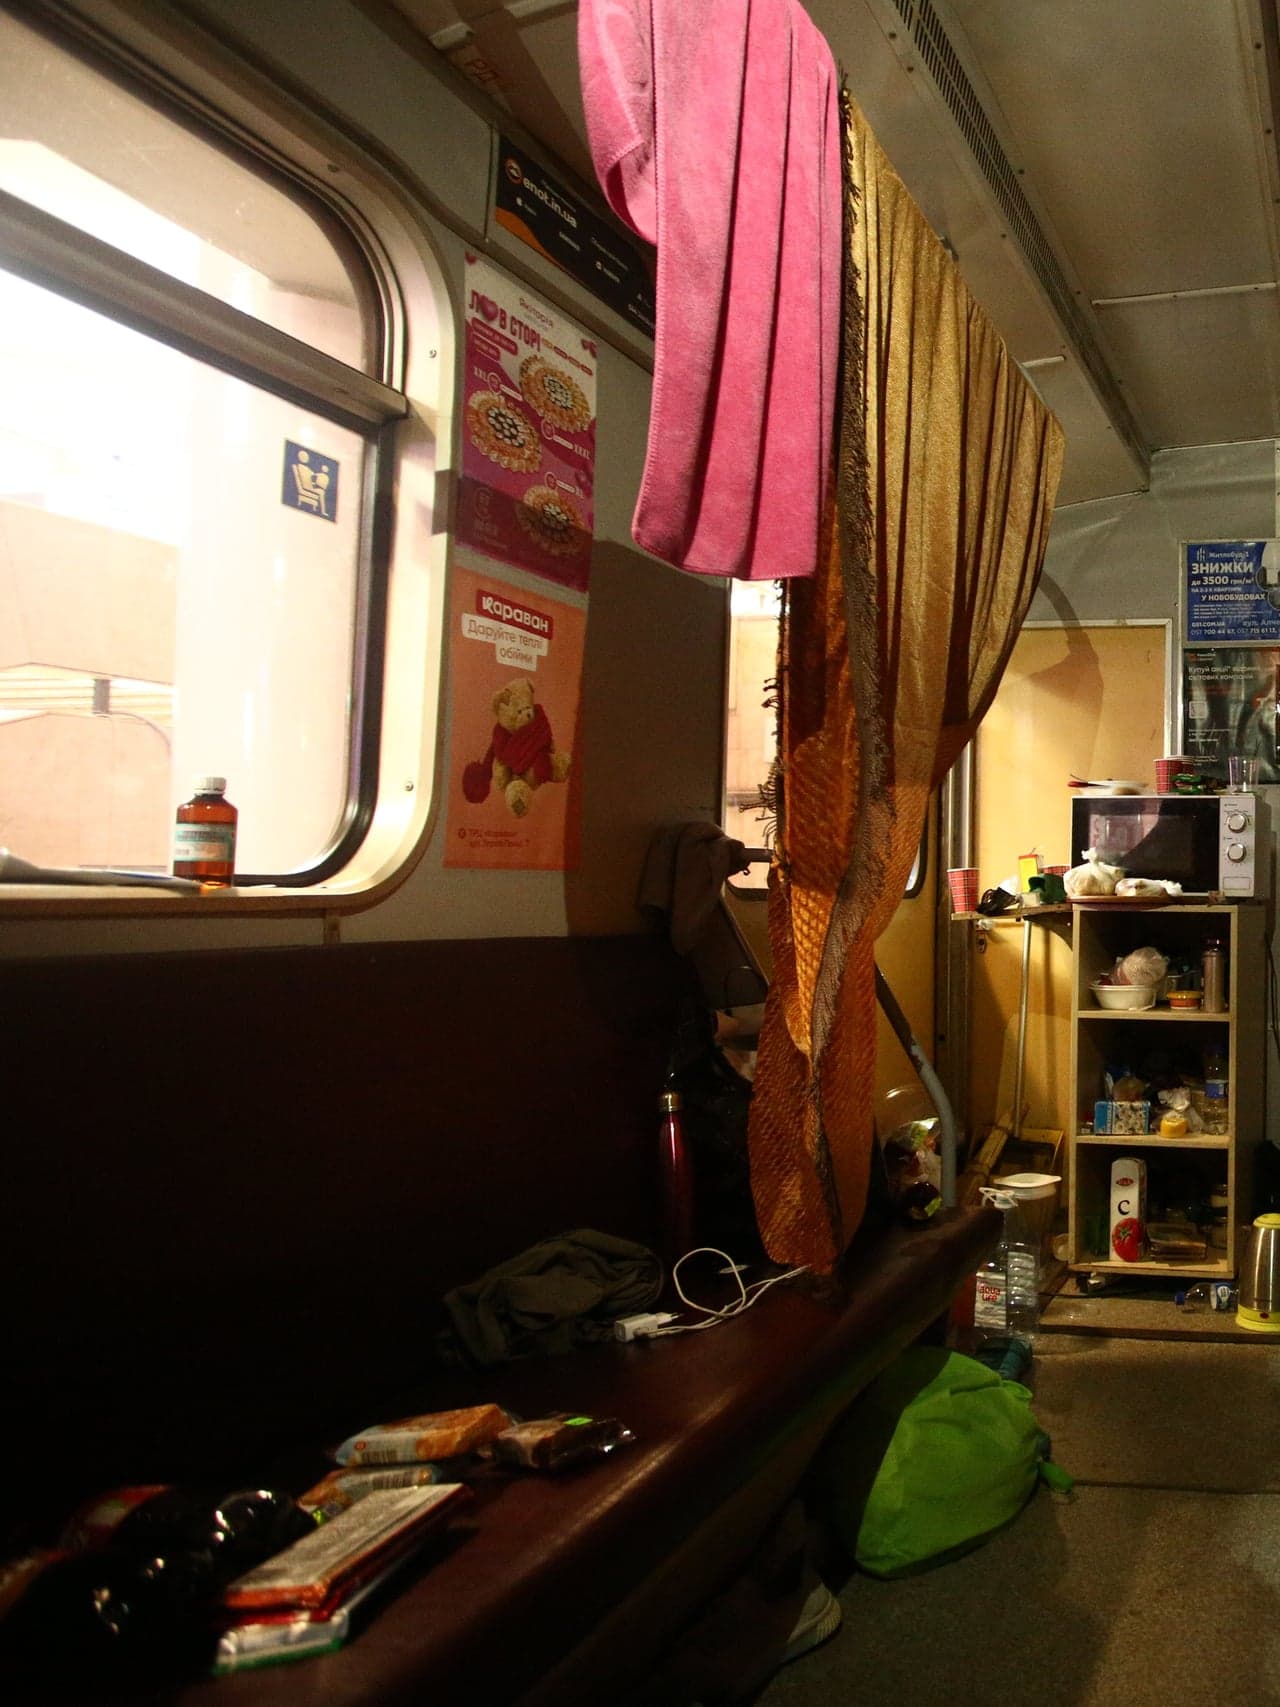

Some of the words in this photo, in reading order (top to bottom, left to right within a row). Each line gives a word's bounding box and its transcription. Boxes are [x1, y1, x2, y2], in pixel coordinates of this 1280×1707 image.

[1191, 562, 1254, 574] ЗНИЖКИ
[1202, 576, 1229, 585] 3500
[468, 619, 516, 642] Даруйте
